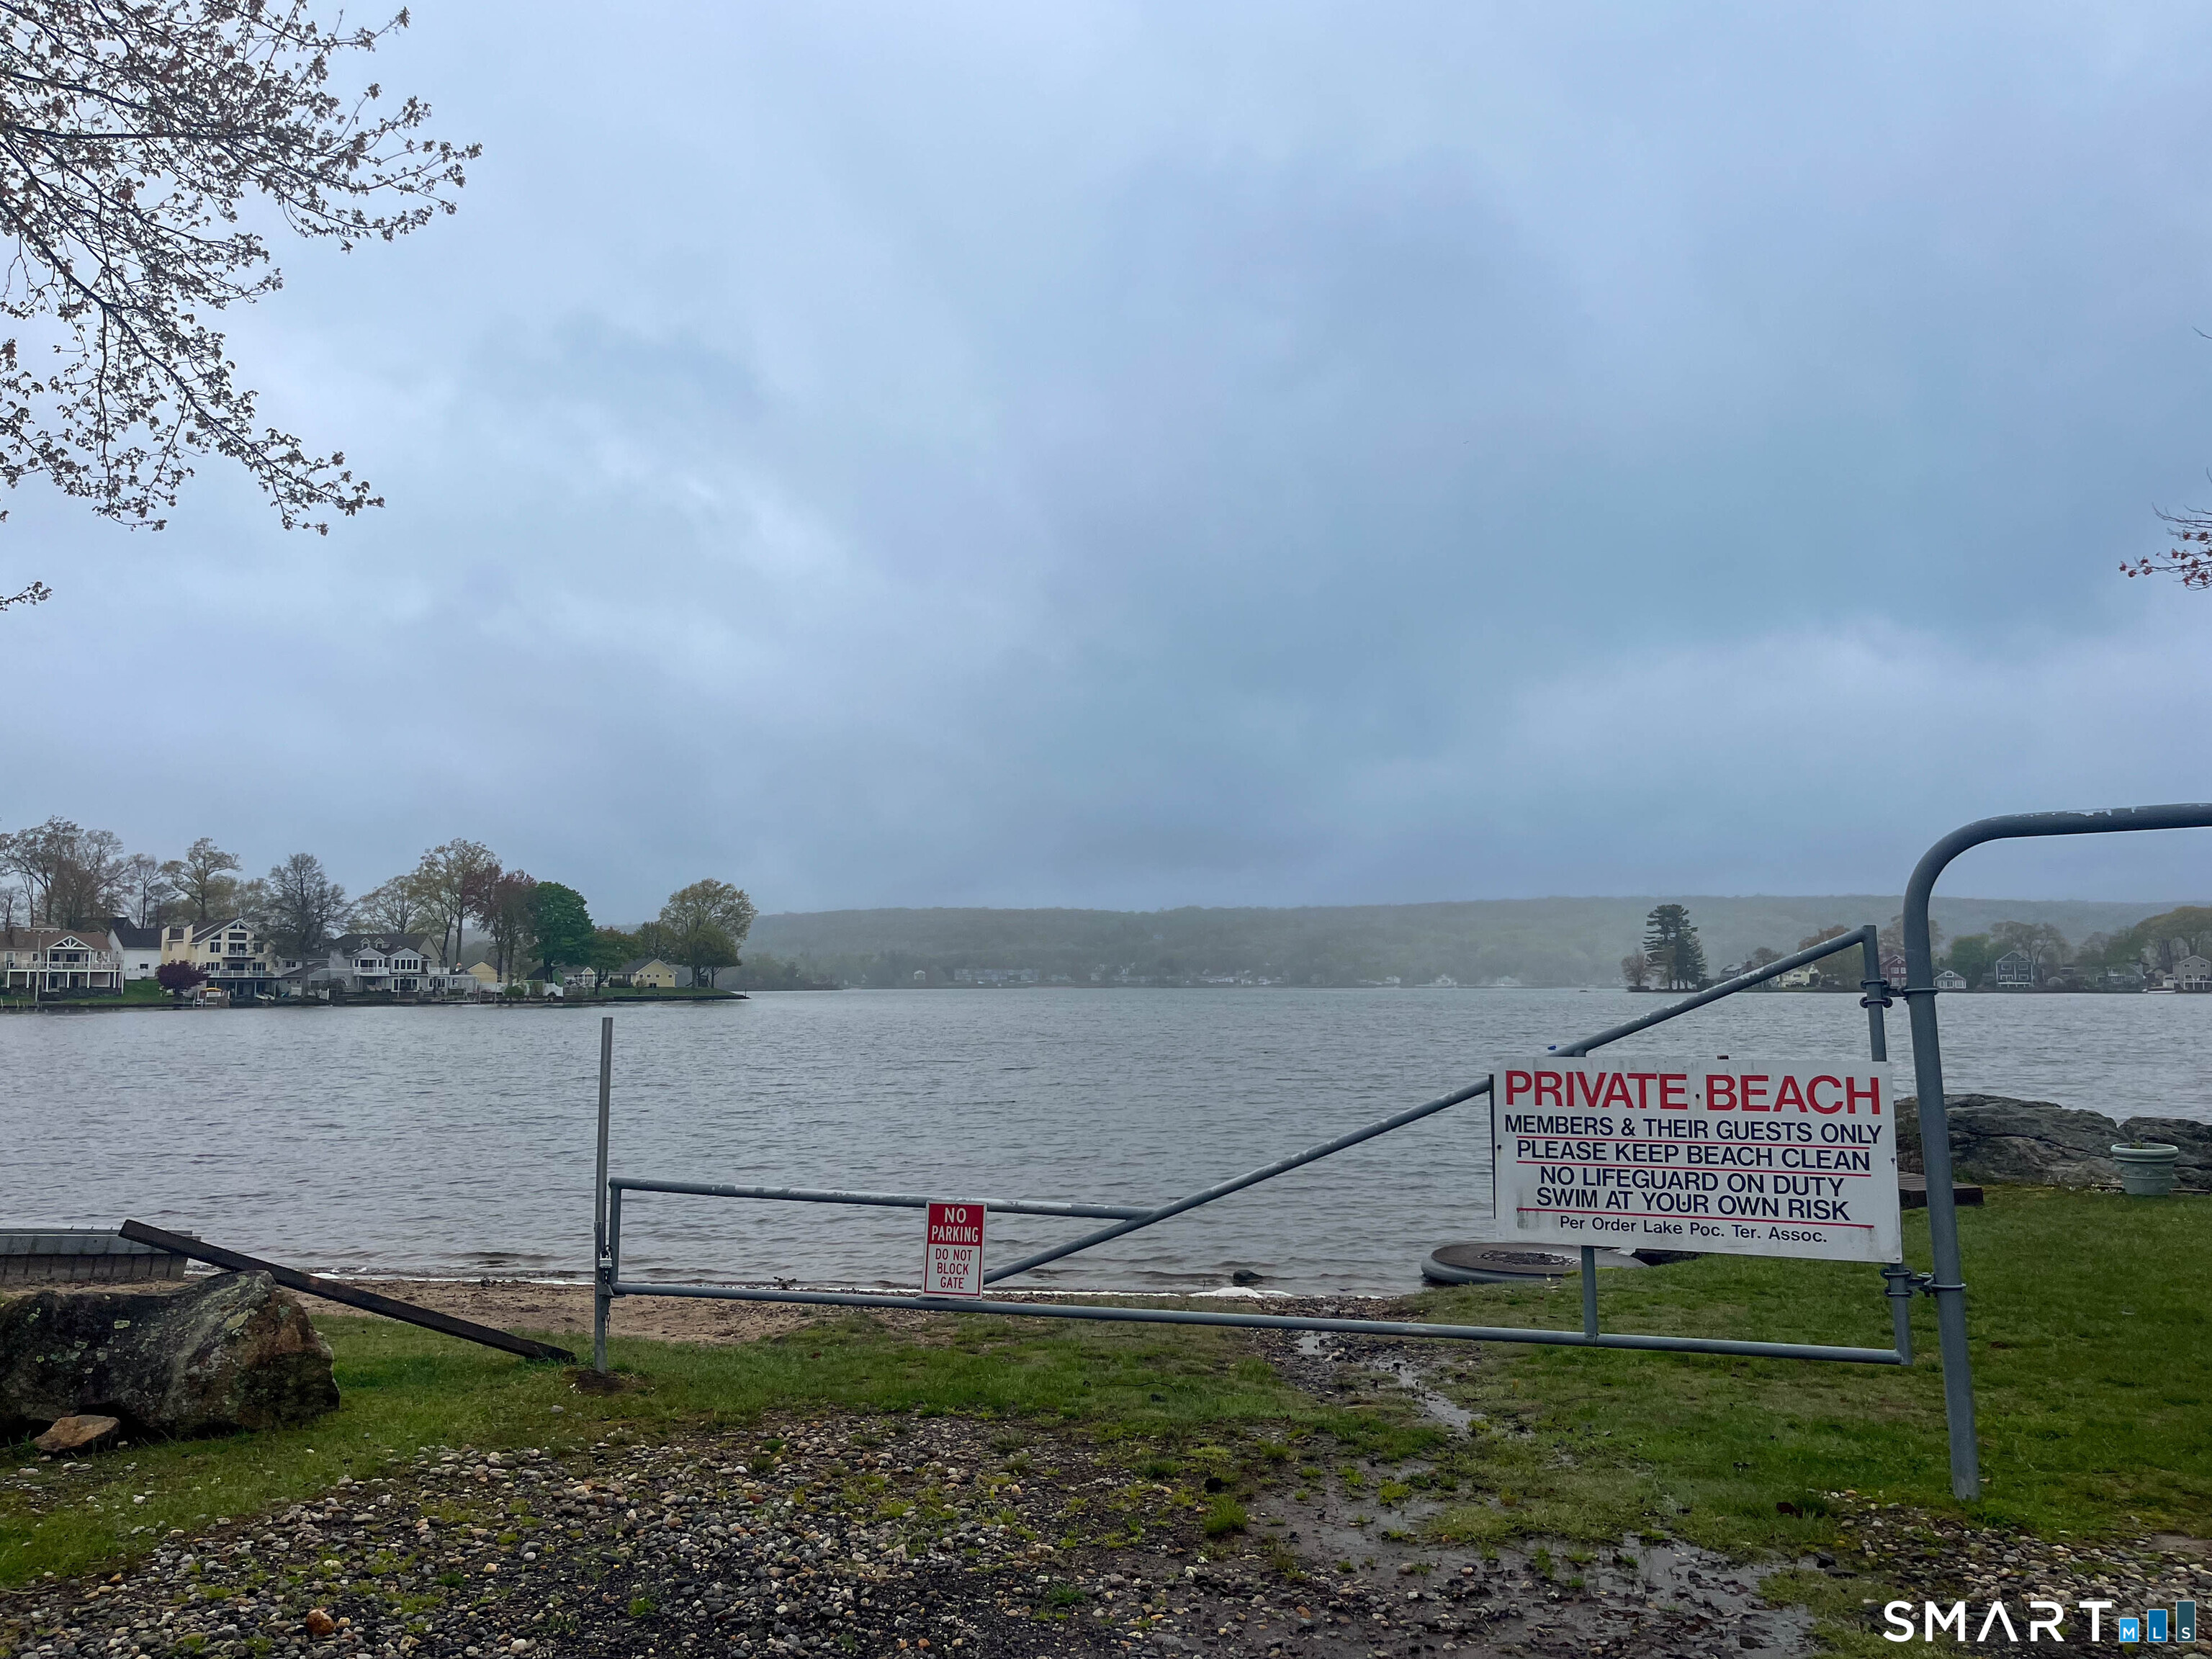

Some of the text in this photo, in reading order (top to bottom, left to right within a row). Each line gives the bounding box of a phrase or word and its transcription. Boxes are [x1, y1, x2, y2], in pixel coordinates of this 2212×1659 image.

[1505, 1070, 1881, 1115] PRIVATE BEACH
[1504, 1115, 1882, 1144] MEMBERS & THEIR GUESTS ONLY
[1517, 1140, 1870, 1171] PLEASE KEEP BEACH CLEAN
[1540, 1166, 1844, 1197] NO LIFEGUARD ON DUTY
[945, 1208, 966, 1223] NO
[1537, 1187, 1851, 1220] SWIM AT YOUR OWN RISK
[932, 1226, 979, 1243] PARKING
[1560, 1216, 1827, 1243] Per Order Lake Poc. Ter. Assoc.
[935, 1249, 972, 1261] DO NOT
[937, 1262, 969, 1275] BLOCK
[940, 1277, 964, 1288] GATE
